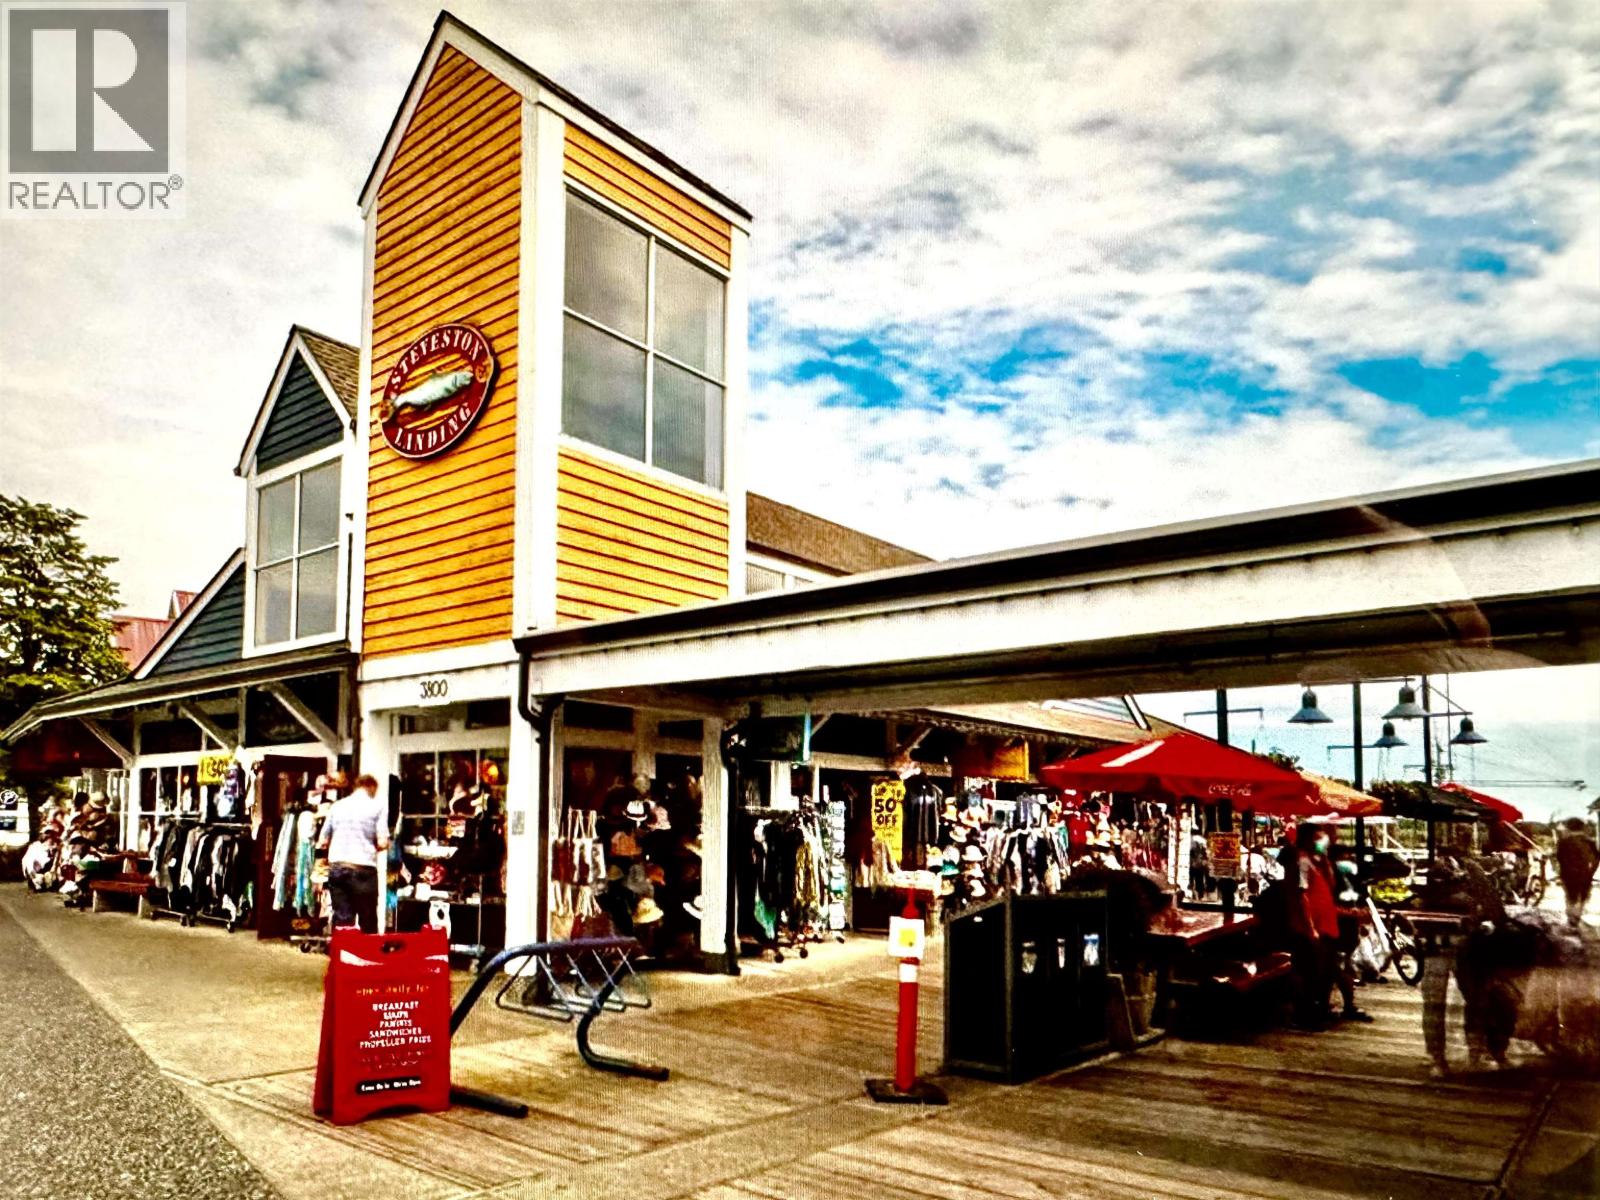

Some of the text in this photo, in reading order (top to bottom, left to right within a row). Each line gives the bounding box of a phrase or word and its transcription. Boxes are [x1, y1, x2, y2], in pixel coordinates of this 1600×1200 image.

[390, 329, 483, 390] STEVESTON
[394, 402, 472, 451] LANDING
[419, 678, 449, 699] 3800
[372, 1001, 419, 1012] BREAKFAST
